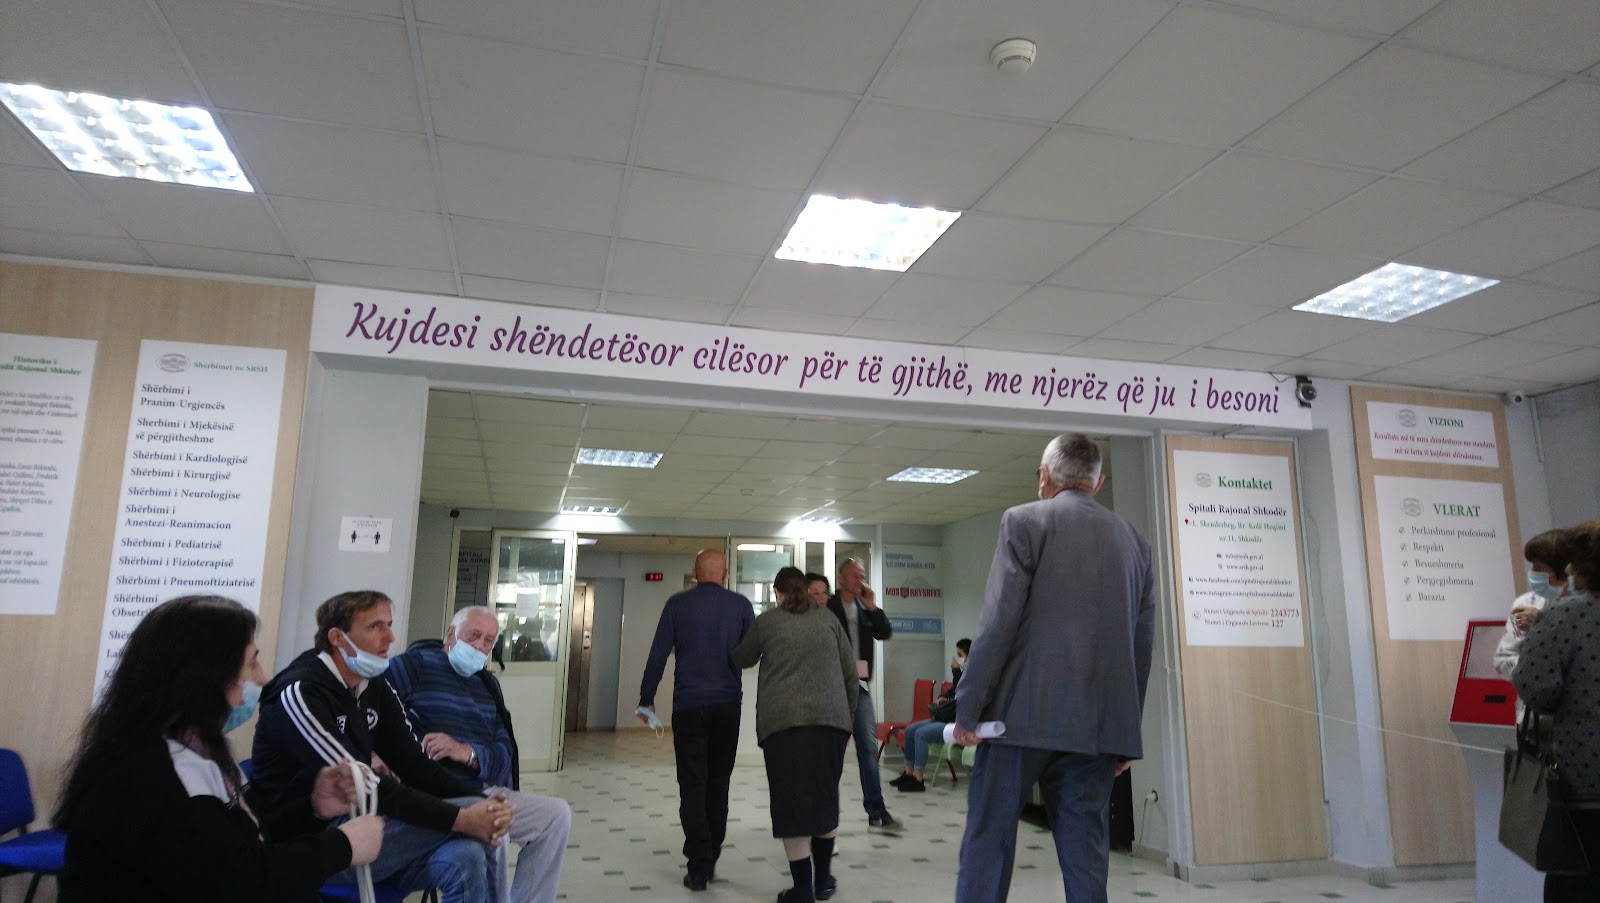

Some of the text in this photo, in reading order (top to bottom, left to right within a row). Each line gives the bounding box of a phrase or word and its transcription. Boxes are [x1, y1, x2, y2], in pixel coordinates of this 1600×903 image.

[345, 302, 1281, 415] Kujdesi shëndetësor cilësor për të gjithë, me njerëz që ju i besoni
[194, 361, 233, 371] Sherbimet
[141, 384, 191, 395] Shërbimi i
[140, 397, 226, 411] Pranim-Urgjencës
[137, 418, 235, 432] Sherbimi i Mjekësisë
[1428, 416, 1464, 428] VIZIONI
[135, 432, 214, 444] së përgjitheshme
[132, 450, 248, 466] Shërbimi i Kardiologjisë
[130, 467, 231, 481] Shërbimi i Kirurgjisë
[1218, 476, 1273, 490] Kontaktet
[127, 487, 171, 497] Shërbimi
[174, 488, 178, 497] i
[125, 504, 176, 515] Shërbimi i
[1188, 503, 1287, 517] Spitali Rajonal Shkodër
[1433, 503, 1480, 518] VLERAT
[124, 518, 231, 530] Anestezi-Reanimacion
[1411, 526, 1496, 539] Perkushtimi profesional
[121, 538, 222, 549] Shërbimi i Pediatrisë
[1413, 542, 1444, 553] Respekti
[118, 556, 234, 569] Shërbimi i Fizioterapisë
[1415, 559, 1464, 570] Besueshmeria
[115, 576, 256, 587] Shërbimi i Pneumoftiziatrisë
[113, 594, 158, 603] Shërbimi
[1418, 592, 1445, 601] Barazia
[1271, 620, 1284, 628] 127
